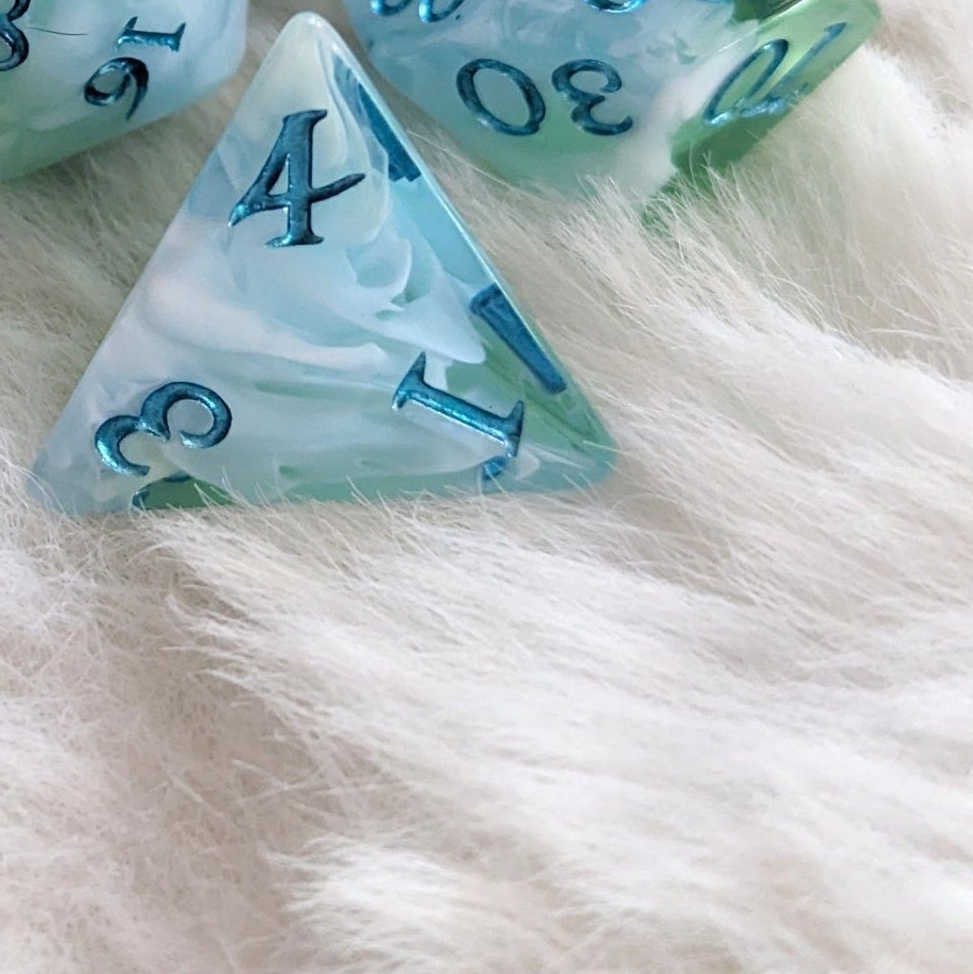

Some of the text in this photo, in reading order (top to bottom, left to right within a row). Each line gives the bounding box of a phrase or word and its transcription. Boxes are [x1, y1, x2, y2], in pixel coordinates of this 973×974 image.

[455, 57, 634, 137] 30
[228, 108, 367, 248] 4
[94, 380, 233, 477] 3
[392, 351, 526, 460] 1
